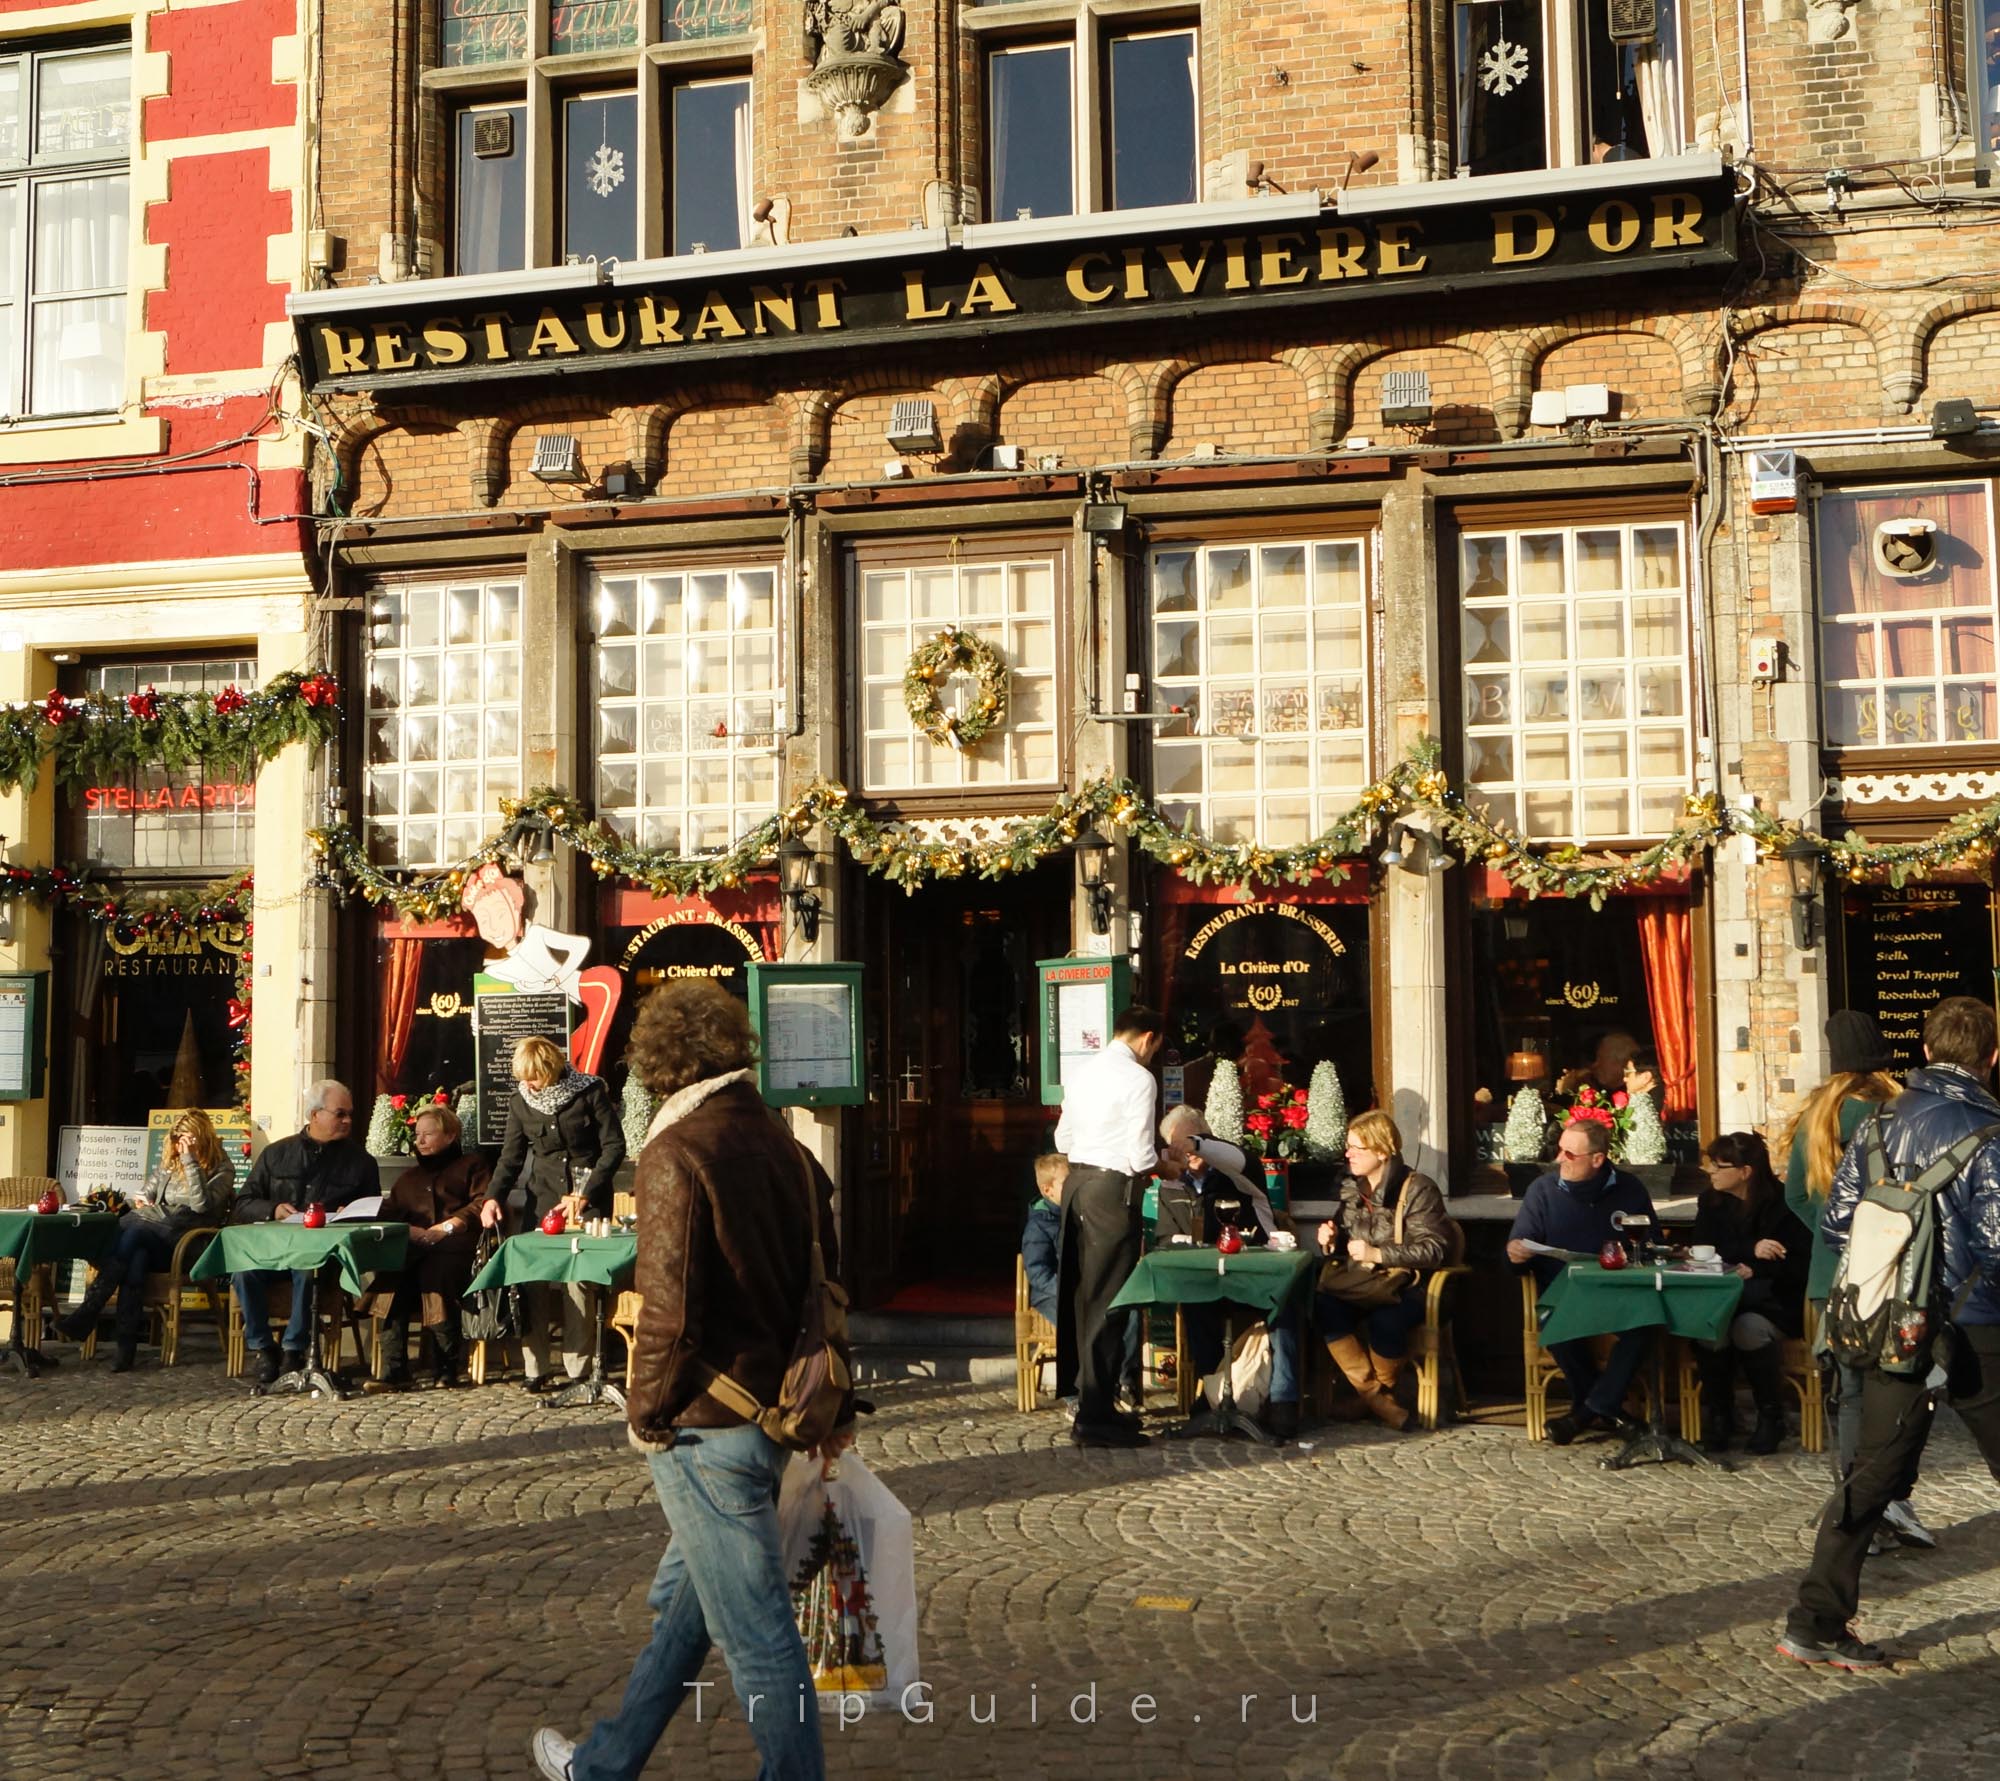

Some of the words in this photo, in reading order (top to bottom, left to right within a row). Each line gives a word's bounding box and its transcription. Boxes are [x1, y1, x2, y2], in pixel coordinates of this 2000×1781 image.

[320, 277, 848, 376] RESTAURANT
[904, 262, 1017, 321] LA
[1066, 219, 1429, 303] CIVIERE
[1492, 192, 1705, 265] D'OR
[85, 786, 174, 810] STELLA
[1185, 901, 1267, 960] RESTAURANT
[1278, 902, 1347, 957] BRASSERIE
[618, 909, 695, 972] RESTAURANT
[1876, 950, 1909, 961] Stella
[651, 966, 666, 978] La
[667, 964, 707, 978] Civière
[1220, 962, 1236, 975] La
[1239, 961, 1280, 974] Civière
[1283, 960, 1310, 973] d'Or
[1045, 969, 1056, 981] LA
[1876, 970, 1910, 981] Orval
[1913, 969, 1960, 982] Trappist
[1255, 986, 1275, 1001] 60
[1282, 999, 1300, 1007] 1947
[1545, 997, 1565, 1005] since
[1572, 985, 1591, 1000] 60
[1600, 996, 1618, 1004] 1947
[1877, 988, 1941, 1000] Rodenbach
[416, 1007, 432, 1015] since
[437, 995, 451, 1009] 60
[1879, 1010, 1919, 1021] Brugse
[76, 1134, 117, 1145] Mosselen
[123, 1134, 141, 1145] Friet
[116, 1147, 137, 1156] Frites
[75, 1159, 108, 1168] Mussels
[115, 1159, 139, 1169] Chips
